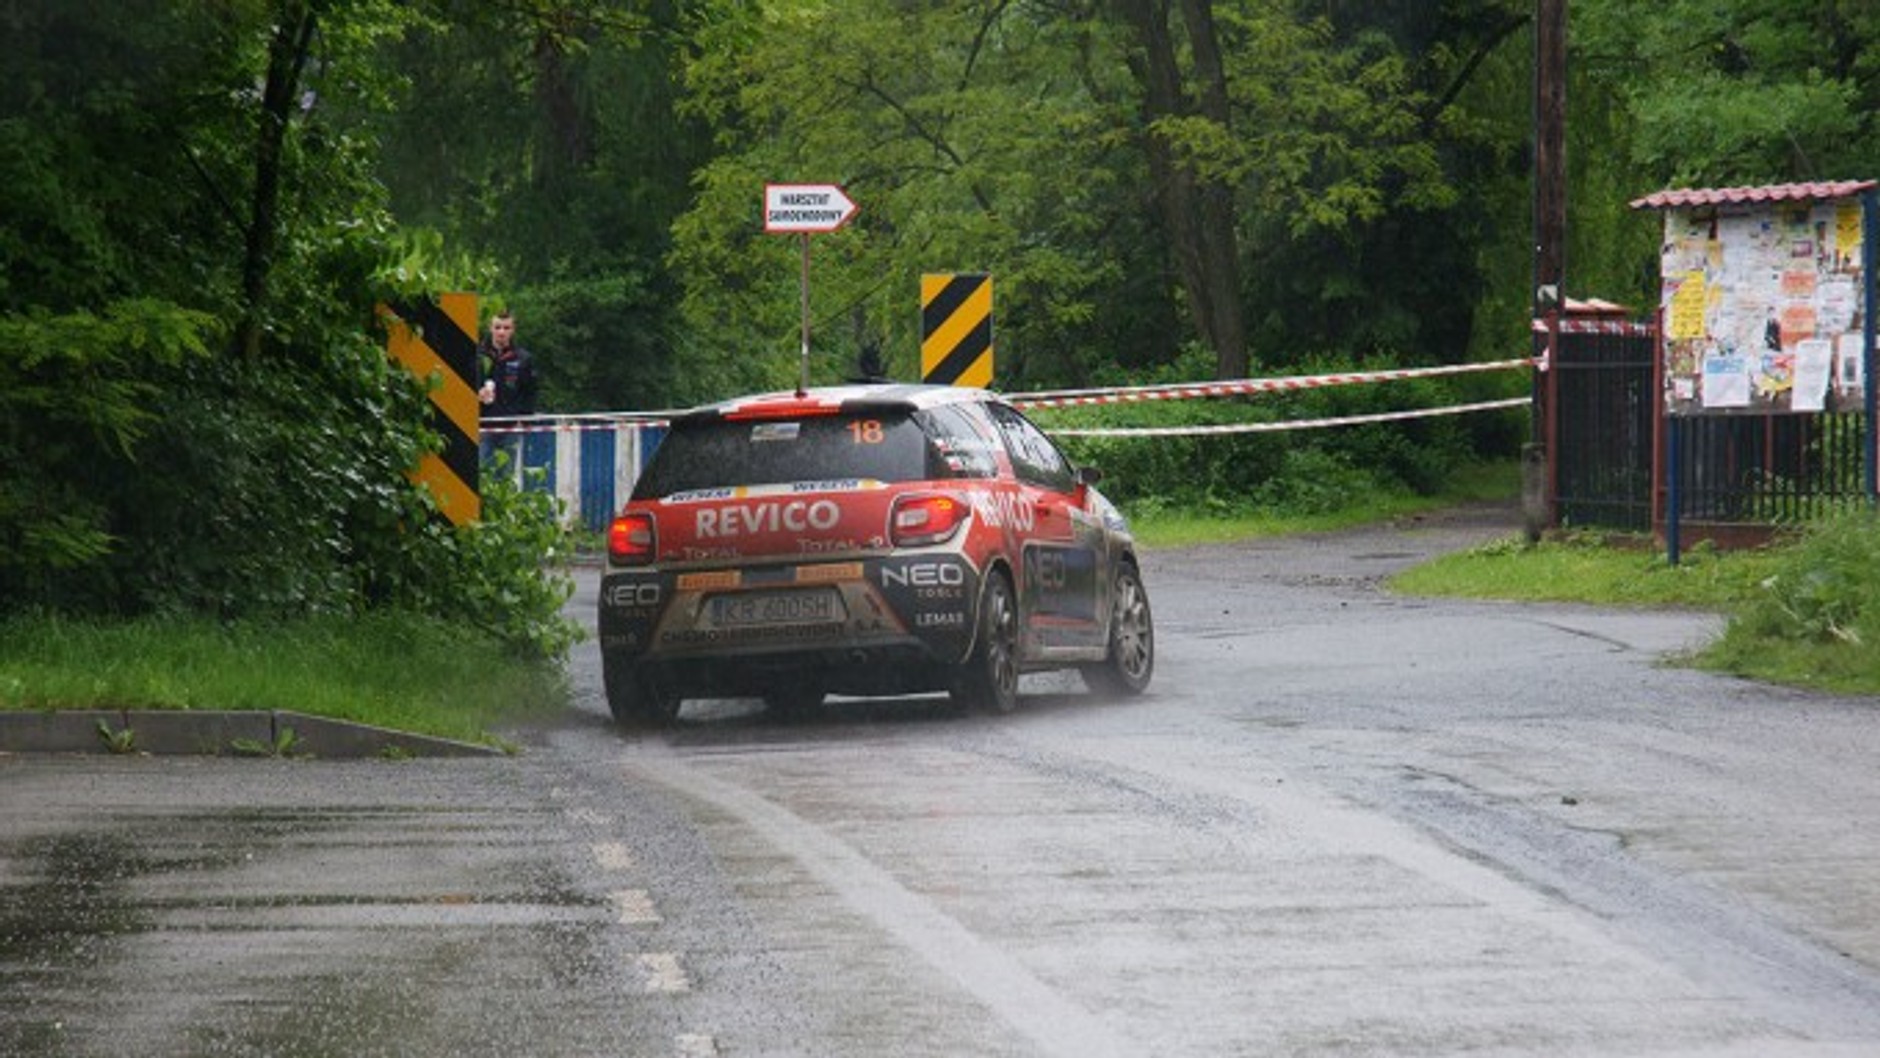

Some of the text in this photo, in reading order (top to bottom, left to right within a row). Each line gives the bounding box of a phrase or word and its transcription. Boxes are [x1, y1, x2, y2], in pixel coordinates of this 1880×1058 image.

[845, 420, 884, 444] 18
[696, 500, 840, 539] REVICO
[882, 563, 963, 588] NEO
[603, 584, 661, 607] NEO
